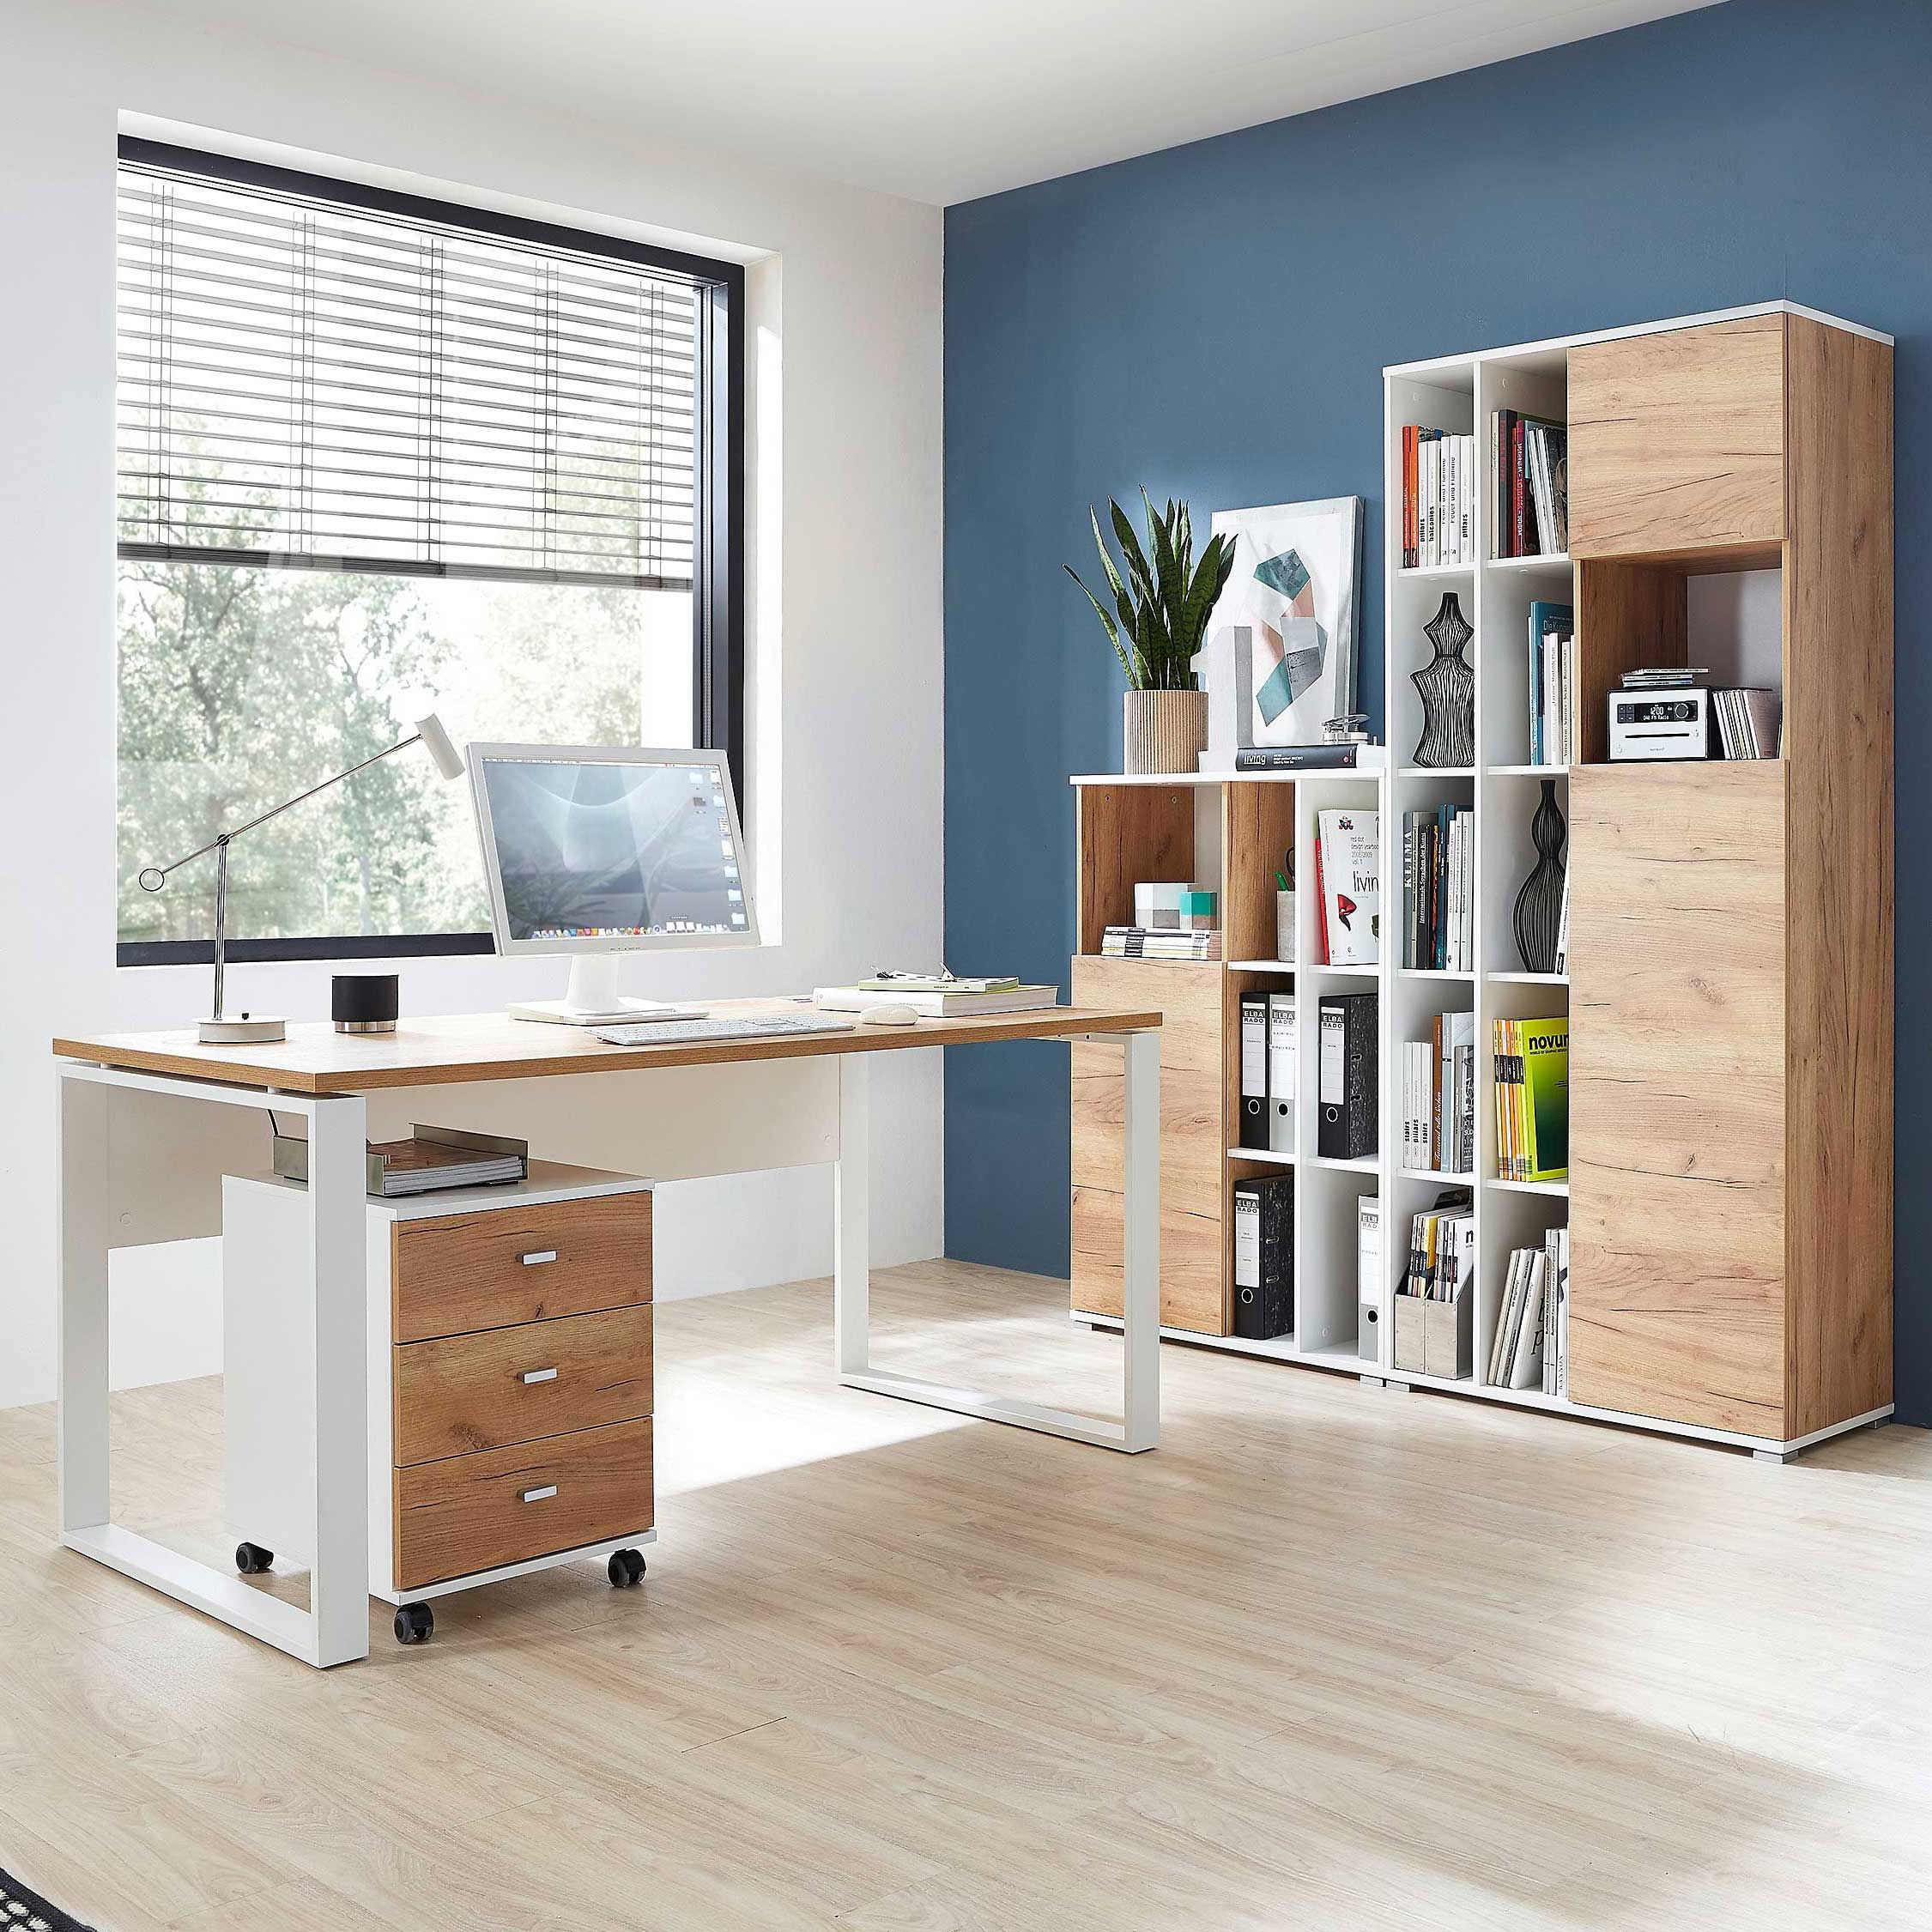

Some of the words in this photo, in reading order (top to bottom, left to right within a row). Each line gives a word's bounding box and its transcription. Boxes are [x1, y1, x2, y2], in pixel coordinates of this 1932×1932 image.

[1244, 754, 1266, 766] living
[1404, 831, 1413, 888] KLIMA
[1353, 870, 1379, 893] livin
